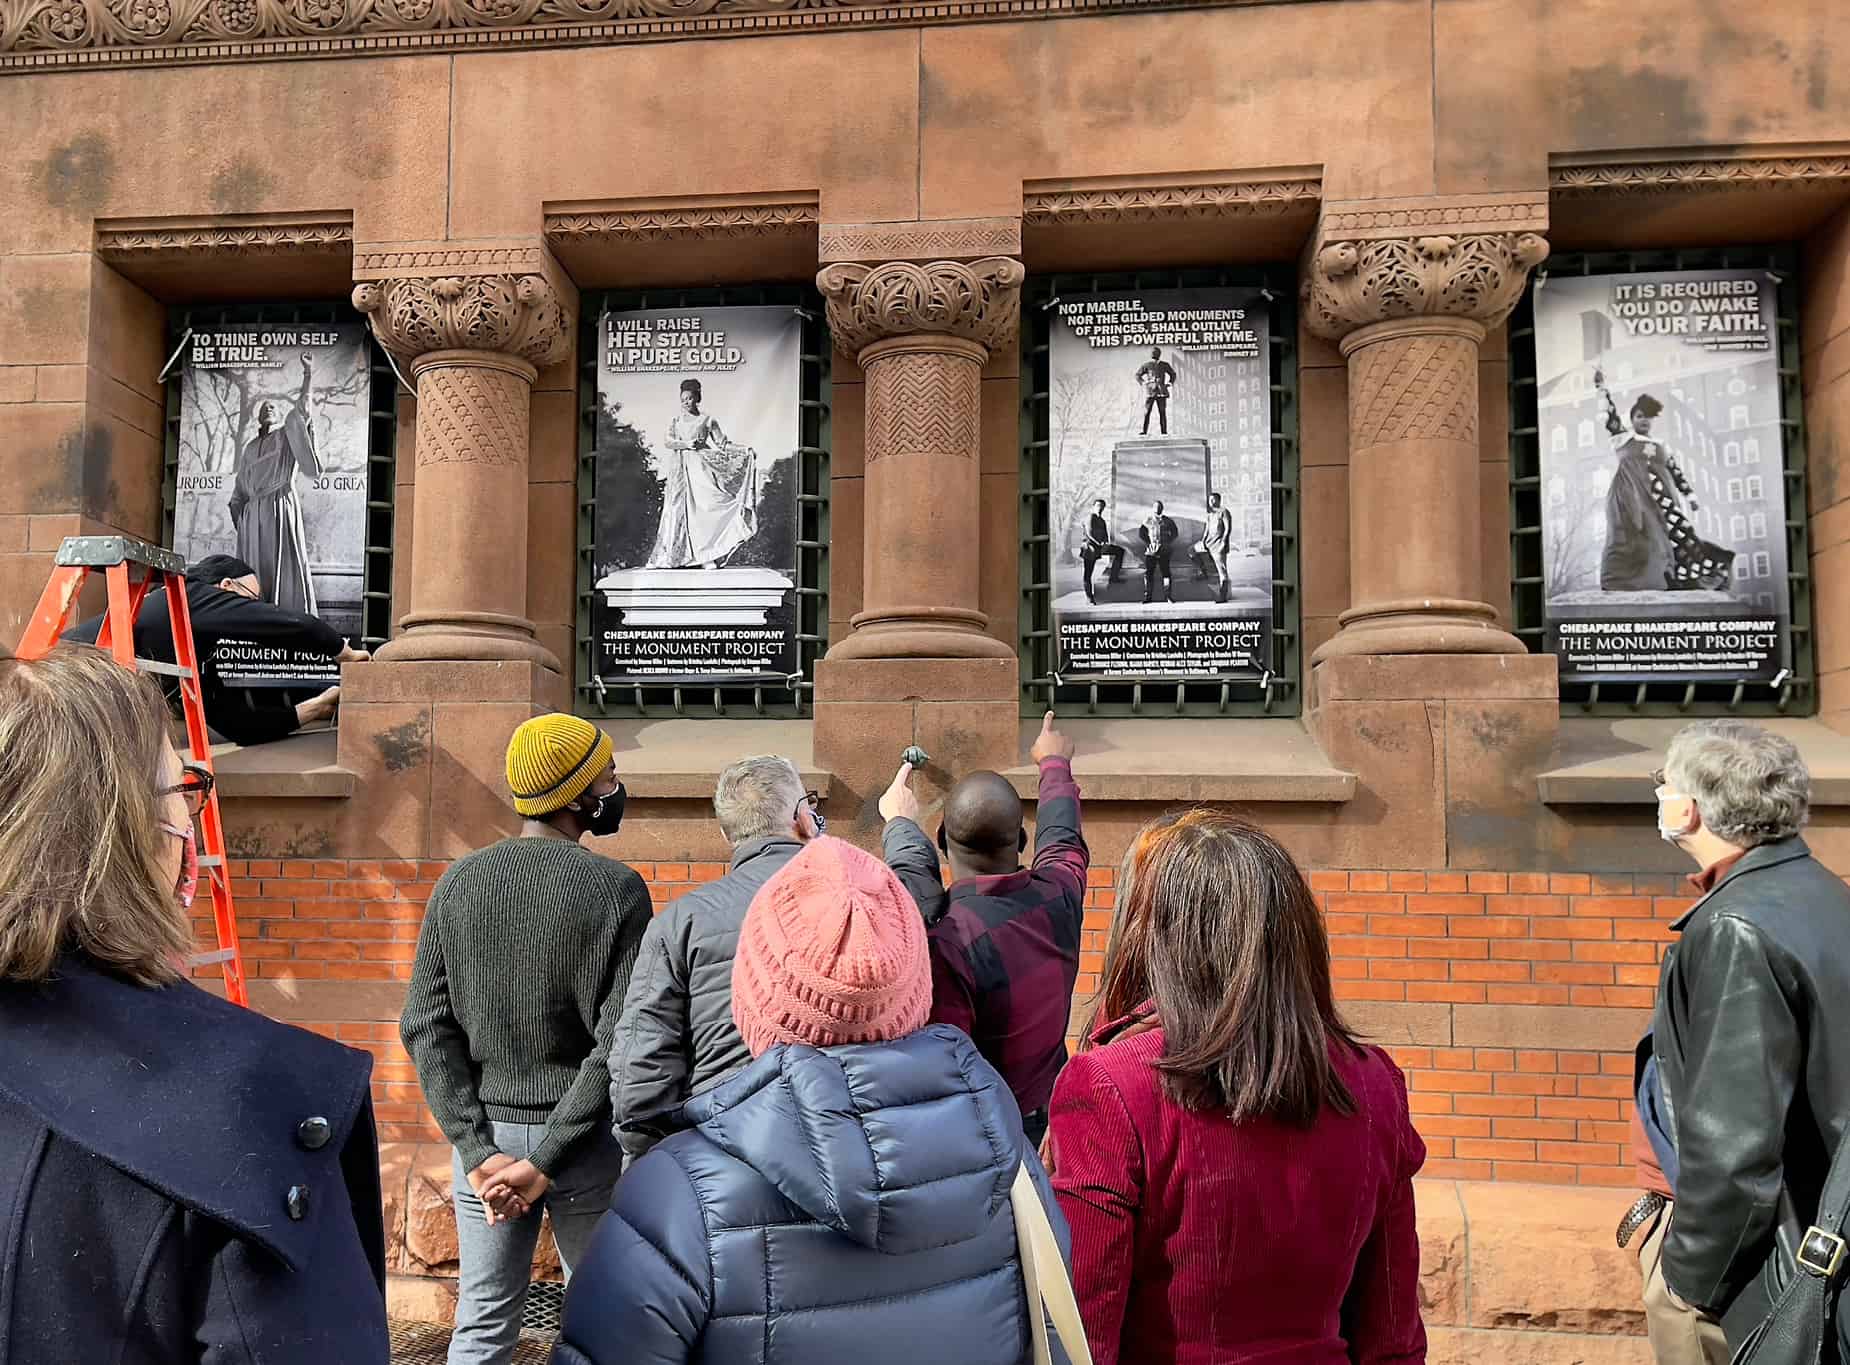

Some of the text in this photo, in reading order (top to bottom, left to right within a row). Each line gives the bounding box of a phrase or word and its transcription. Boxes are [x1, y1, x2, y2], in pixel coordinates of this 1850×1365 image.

[1616, 281, 1757, 299] IT IS REQUIRED
[1059, 300, 1144, 315] NOT MARBLE,
[1612, 297, 1759, 316] YOU DO AWAKE
[608, 318, 700, 331] I WILL RAISE
[1068, 310, 1244, 326] NOR THE GILDED MONUMENTS
[1625, 314, 1767, 334] YOUR FAITH.
[1076, 321, 1241, 336] OF PRINCES, SHALL OUTLIVE
[192, 333, 338, 346] TO THINE OWN SELF
[608, 332, 724, 348] HER STATUE
[1089, 331, 1257, 347] THIS POWERFUL RHYME.
[192, 347, 268, 362] BE TRUE.
[608, 349, 746, 365] IN PURE GOLD.
[313, 477, 329, 489] SO
[604, 631, 784, 639] CHESAPEAKE SHAKESPEARE COMPANY
[1062, 622, 1260, 634] CHESAPEAKE SHAKESPEARE COMPANY
[1560, 621, 1775, 634] CHESAPEAKE SHAKESPEARE COMPANY
[603, 642, 785, 656] THE MONUMENT PROJECT
[1061, 634, 1261, 650] THE MONUMENT PROJECT
[1560, 634, 1777, 650] THE MONUMENT PROJECT
